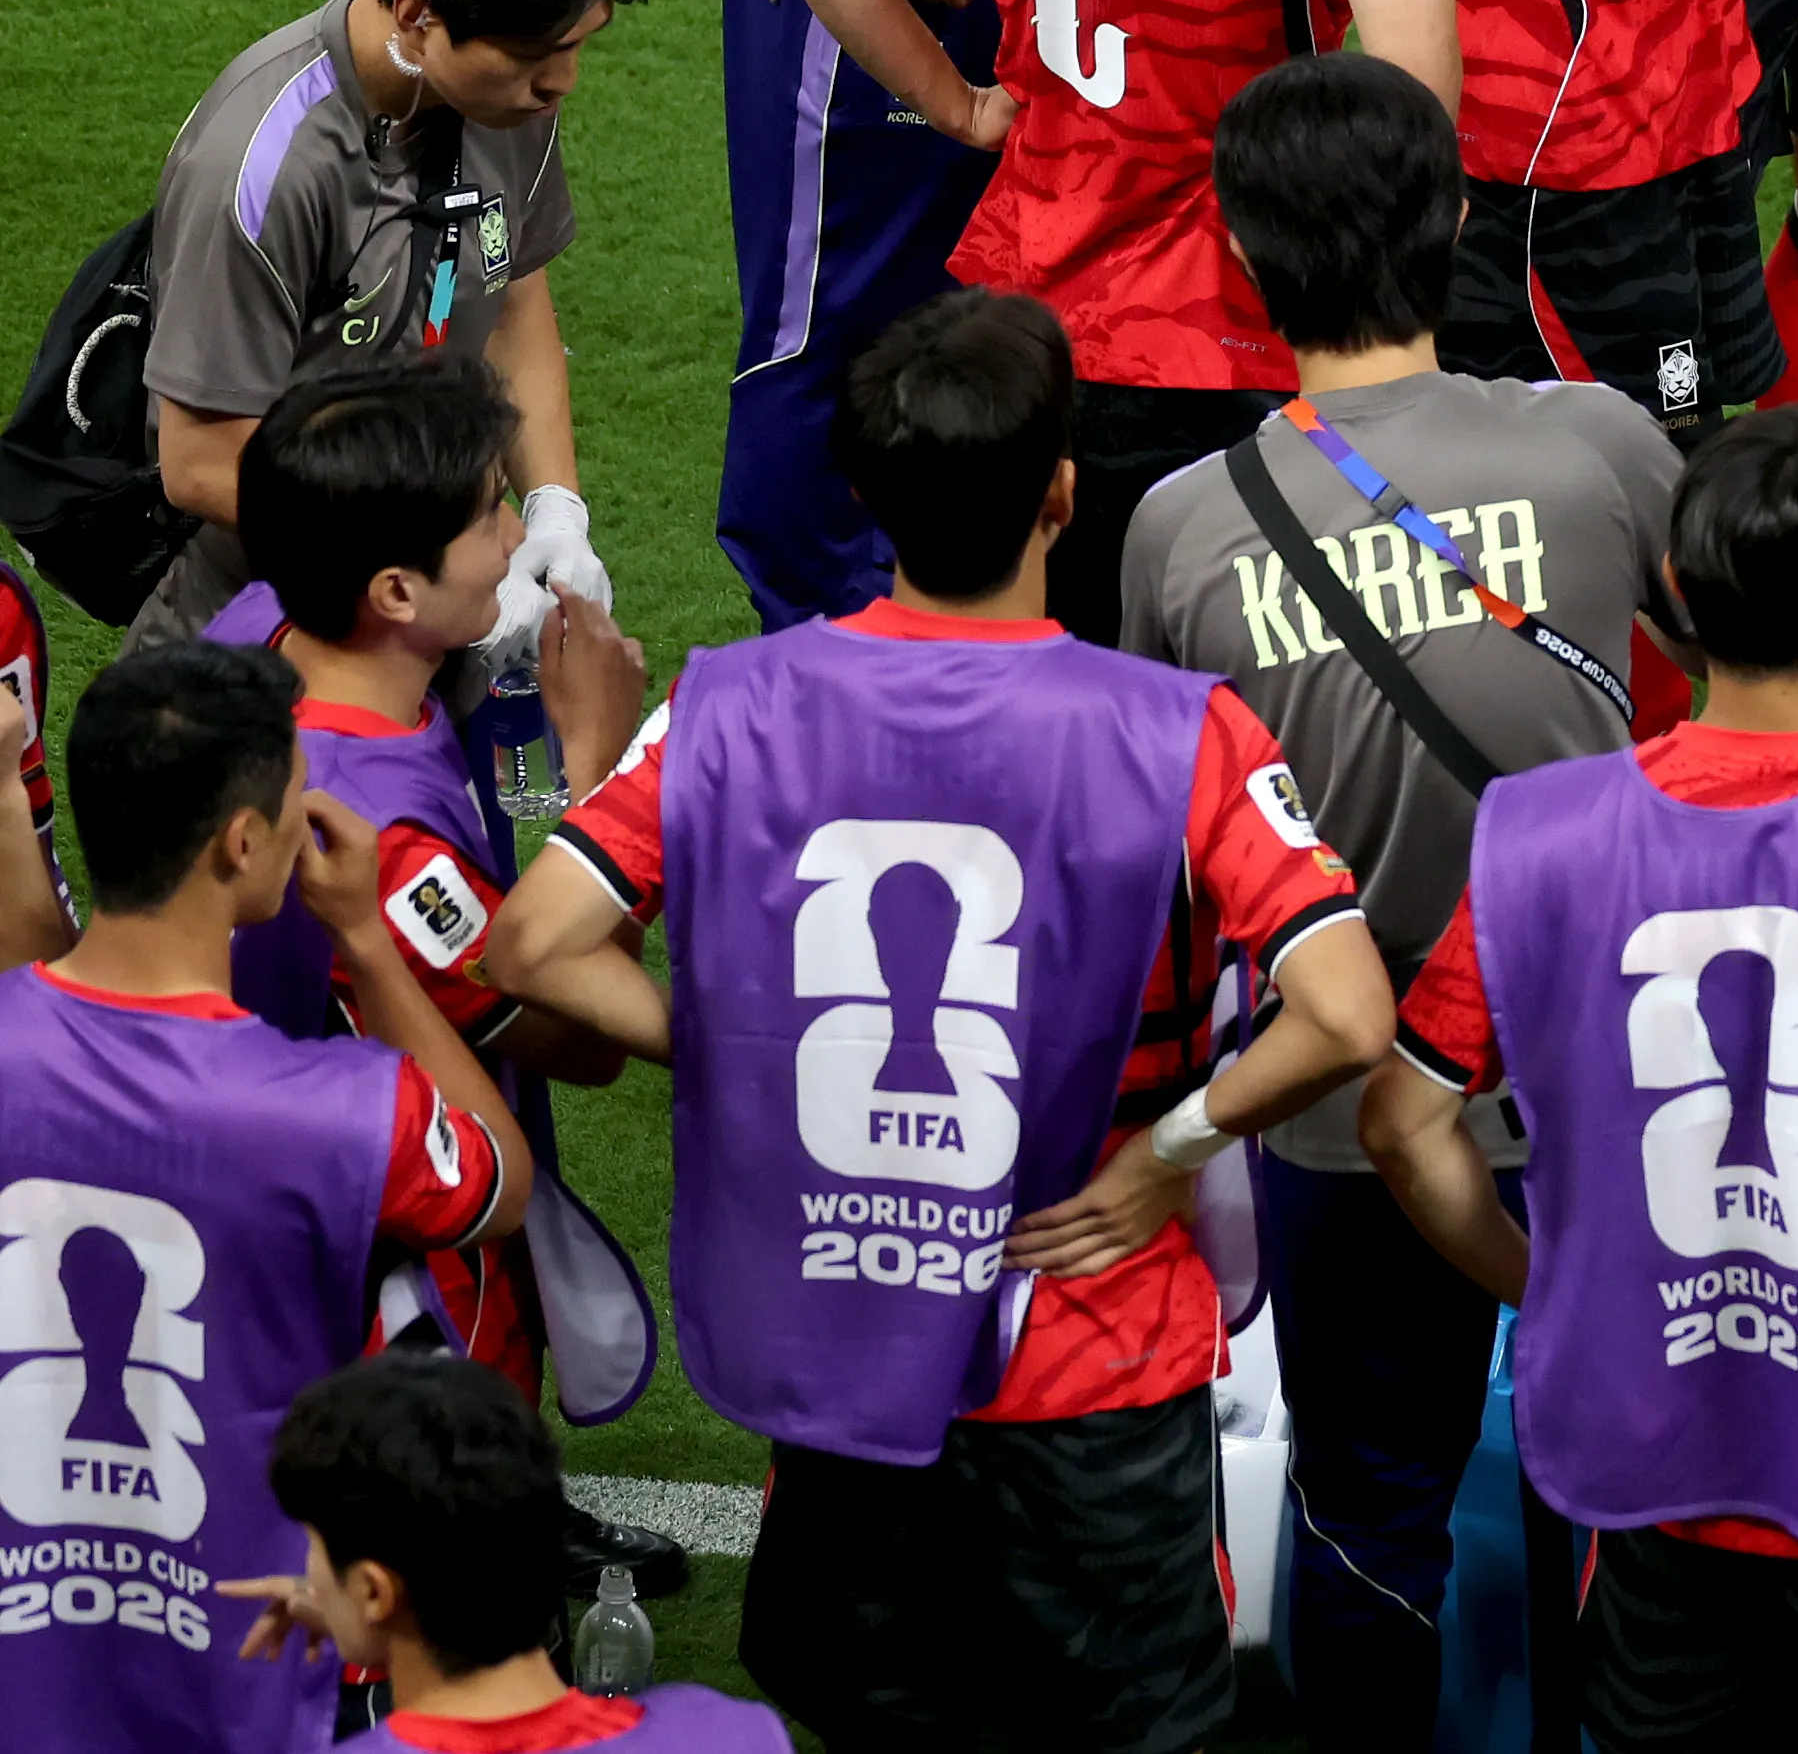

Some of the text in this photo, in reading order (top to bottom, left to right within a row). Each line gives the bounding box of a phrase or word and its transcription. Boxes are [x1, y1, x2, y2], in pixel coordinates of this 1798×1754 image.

[342, 315, 379, 346] CJ
[1232, 498, 1548, 671] KOREA
[1535, 627, 1584, 666] 2026
[1582, 659, 1606, 685] CUP
[868, 1108, 966, 1154] FIFA
[800, 1192, 1015, 1240] WORLD CUP
[1714, 1184, 1789, 1235] FIFA
[1658, 1267, 1780, 1313] WORLD
[60, 1458, 162, 1503] FIFA
[0, 1538, 209, 1596] WORLD CUP
